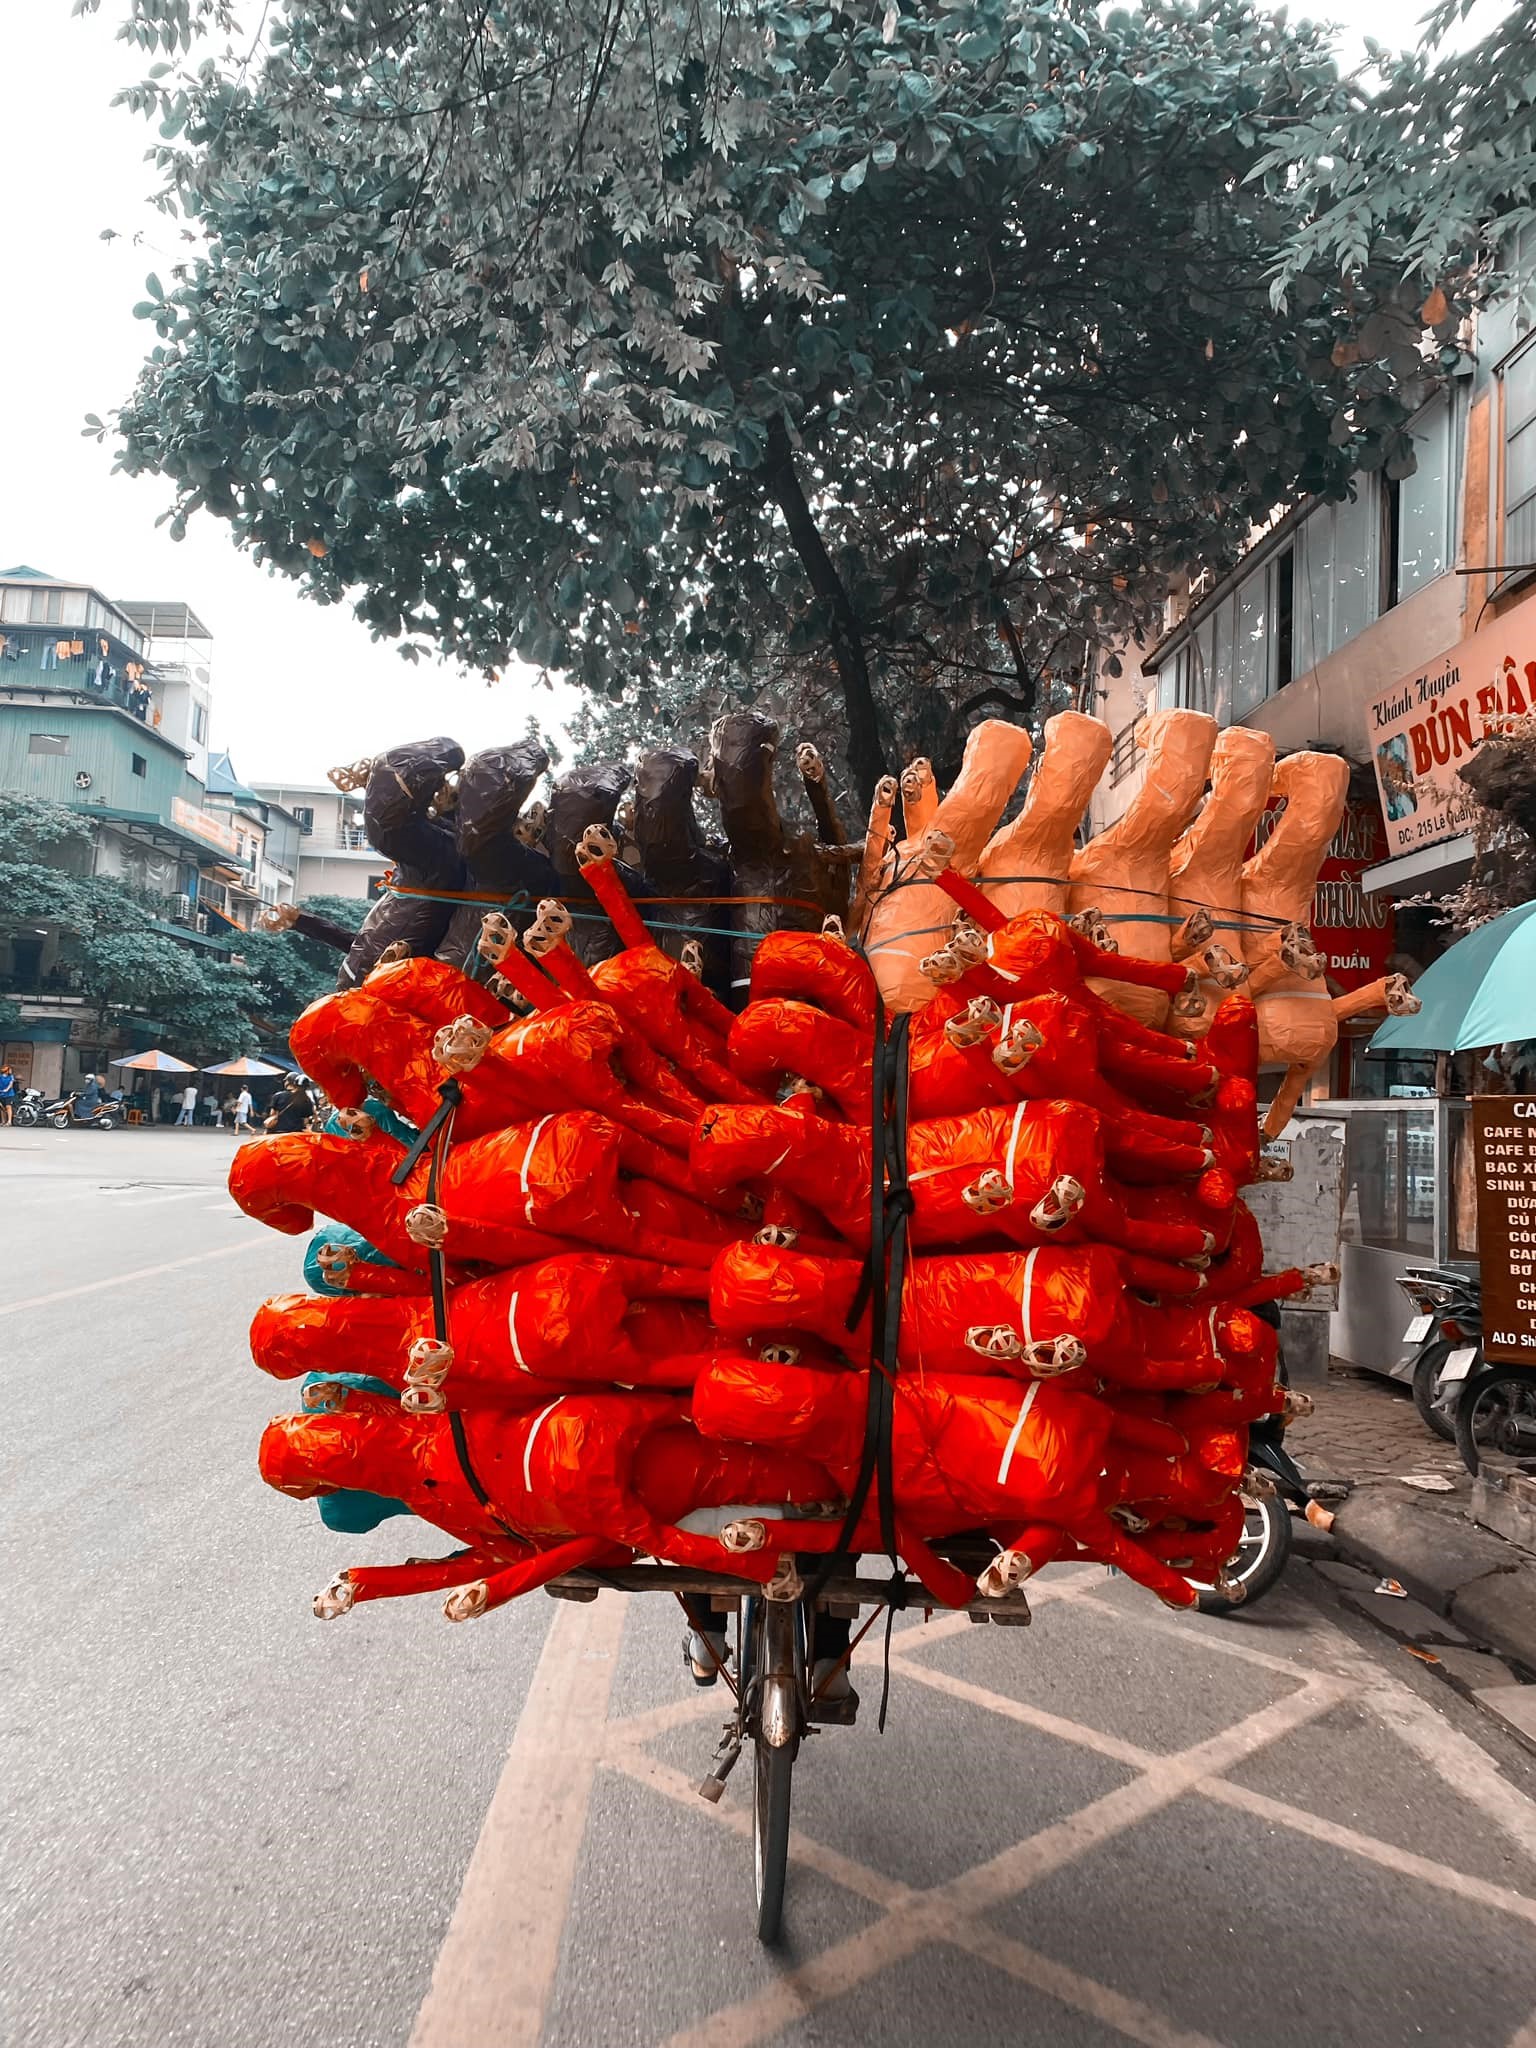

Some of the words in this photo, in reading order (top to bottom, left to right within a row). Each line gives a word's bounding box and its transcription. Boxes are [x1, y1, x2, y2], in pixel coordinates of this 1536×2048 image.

[1372, 688, 1413, 731] Khánh
[1415, 659, 1461, 705] Huyền
[1409, 699, 1474, 776] BÚN
[1476, 655, 1536, 740] ĐẬ
[1417, 819, 1433, 838] 215
[1434, 813, 1446, 831] Lê
[1483, 1126, 1524, 1138] CAFE
[1484, 1144, 1525, 1156] CAFE
[1485, 1161, 1518, 1175] BẠC
[1486, 1179, 1525, 1191] SINH
[1510, 1263, 1532, 1276] BƠ
[1492, 1331, 1517, 1345] ALO
